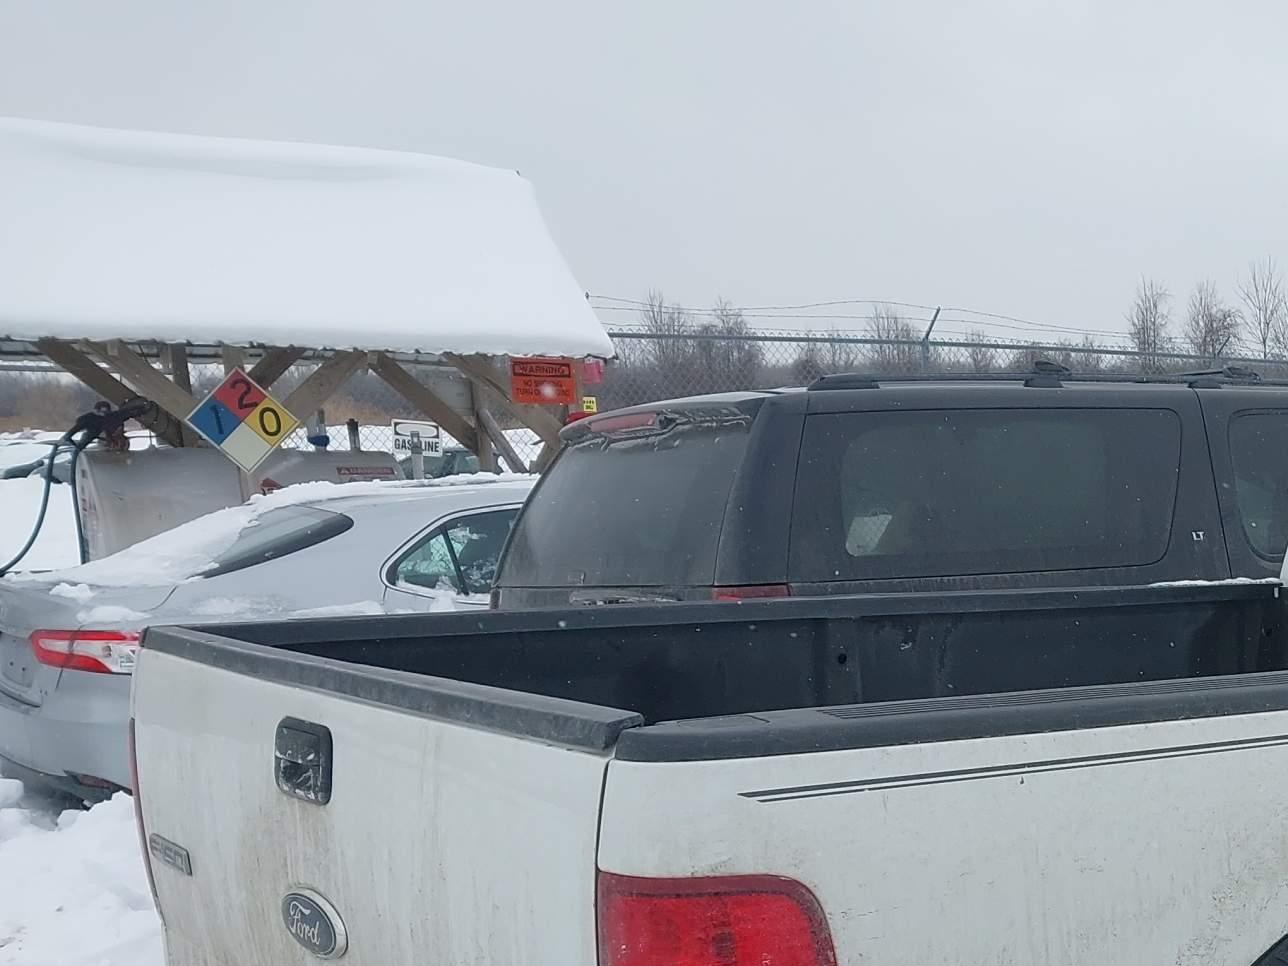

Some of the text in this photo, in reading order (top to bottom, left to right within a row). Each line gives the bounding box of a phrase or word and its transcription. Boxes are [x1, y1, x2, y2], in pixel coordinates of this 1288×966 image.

[519, 364, 565, 375] WARNING
[230, 378, 259, 410] 2
[209, 404, 225, 435] 1
[259, 406, 282, 437] 0
[394, 438, 440, 453] GASLINE
[1191, 531, 1205, 541] LT
[289, 901, 320, 945] Ford
